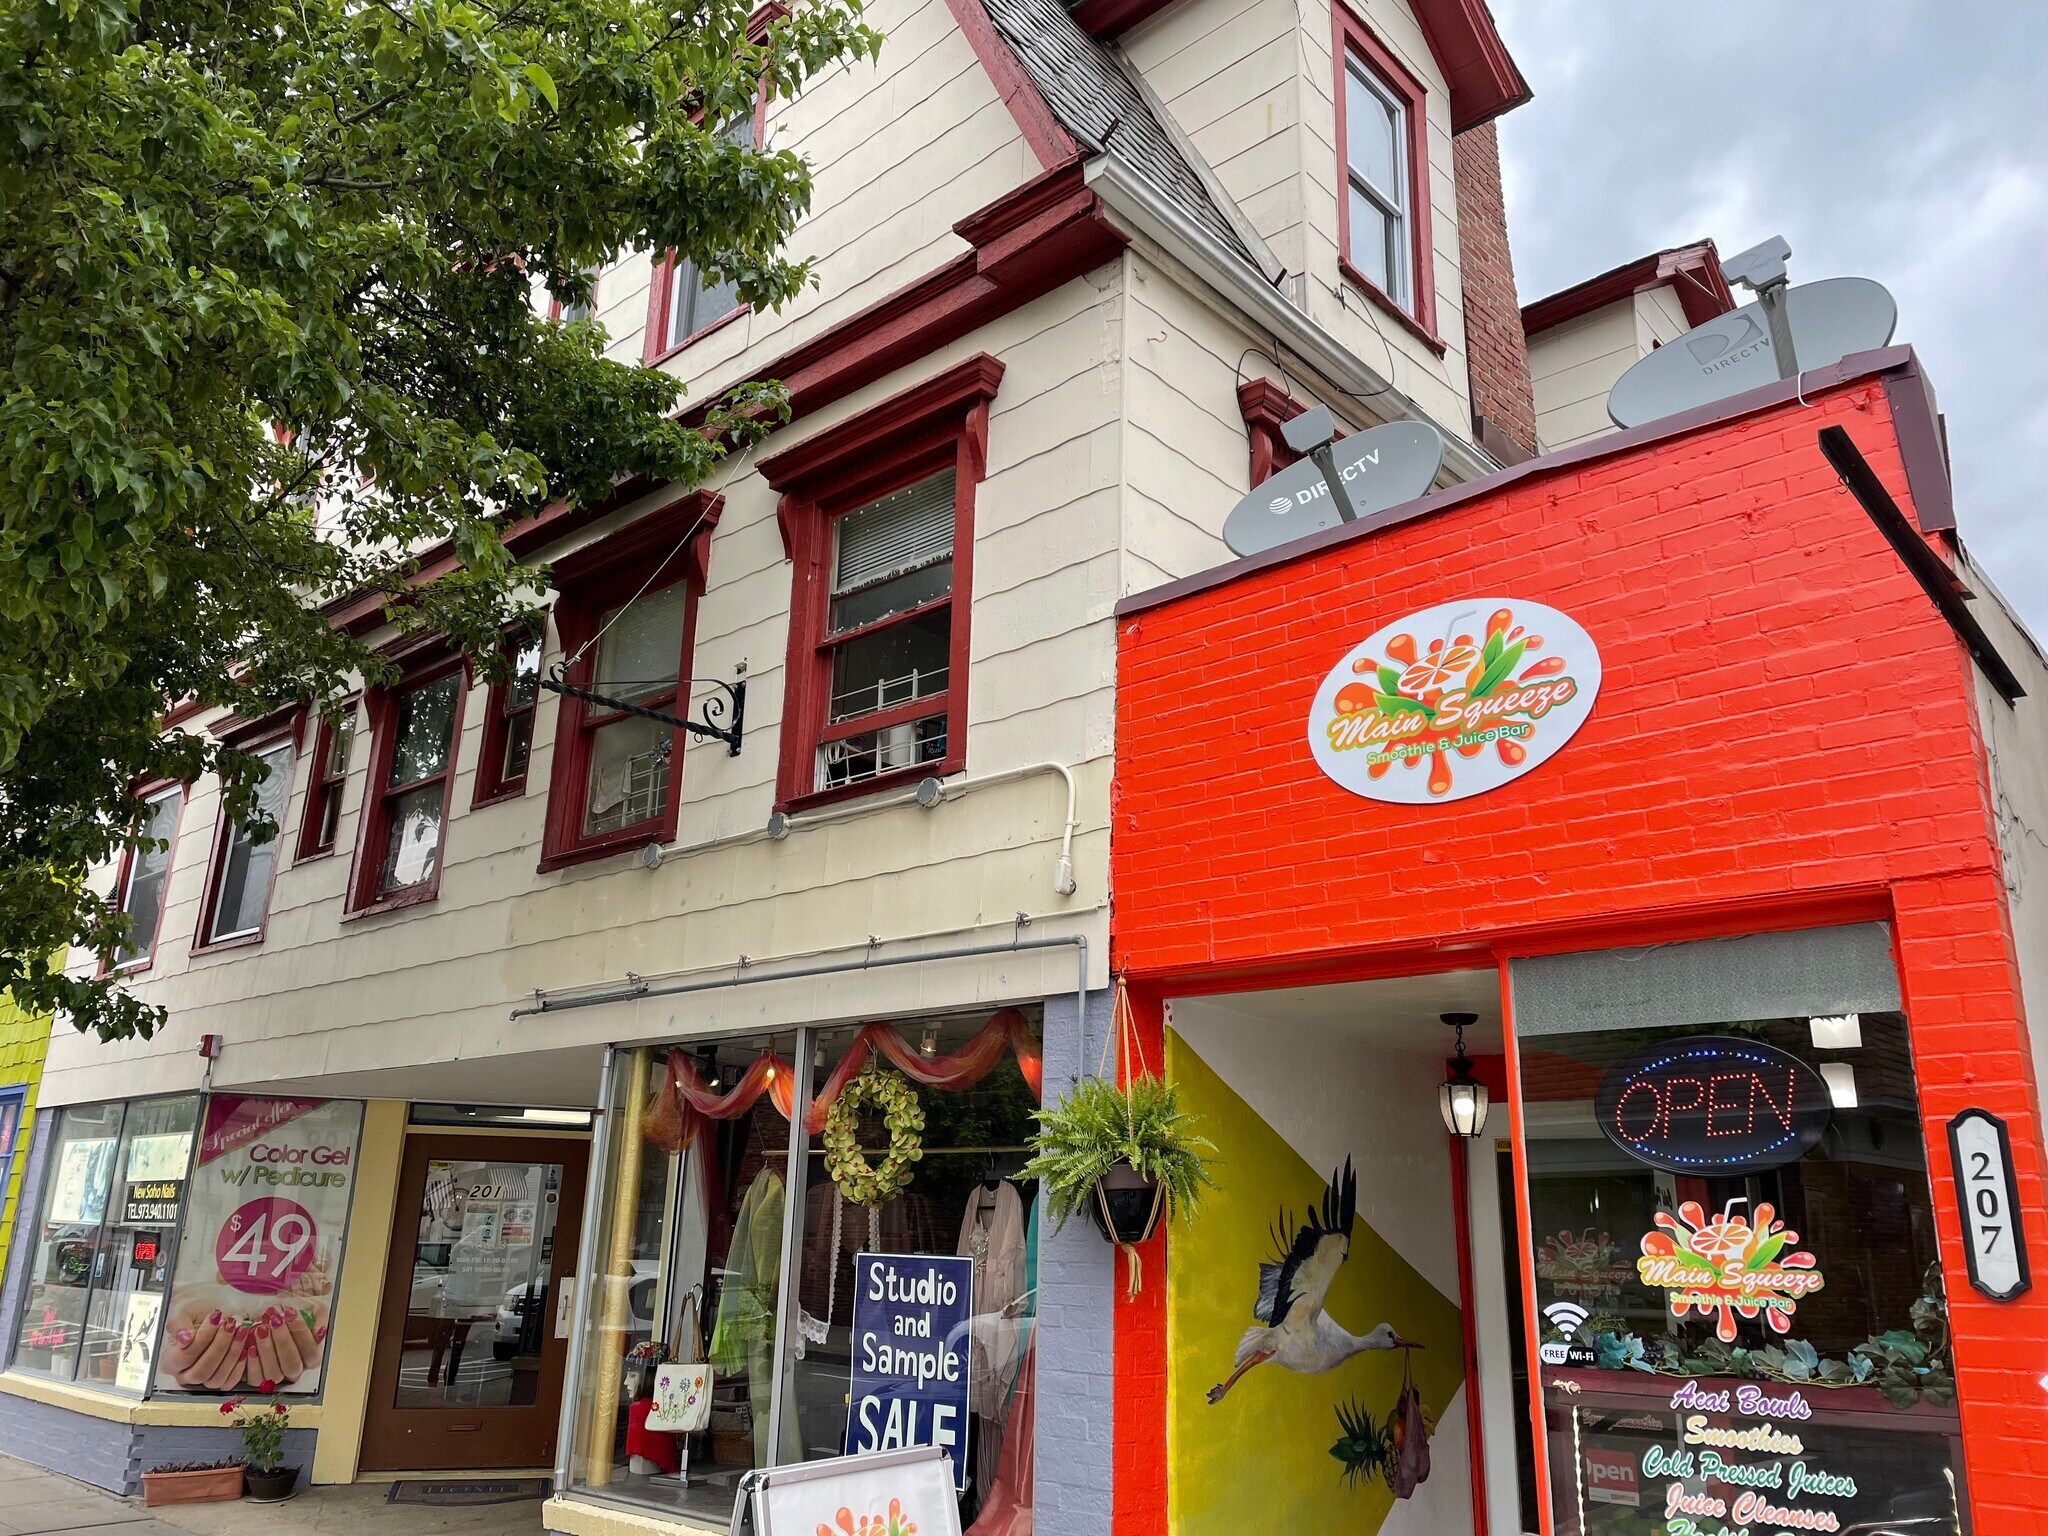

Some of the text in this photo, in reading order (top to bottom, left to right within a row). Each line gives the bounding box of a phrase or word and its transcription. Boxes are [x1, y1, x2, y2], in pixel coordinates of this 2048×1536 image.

[1703, 338, 1770, 376] DIRECTV
[1330, 681, 1573, 748] Main Squeeze
[1367, 722, 1529, 766] Smoothie & Juice Bar
[1616, 1068, 1796, 1142] OPEN
[204, 1100, 294, 1152] Special offer
[250, 1143, 350, 1166] Color Gel
[133, 1185, 146, 1199] New
[161, 1183, 176, 1199] Nails
[220, 1165, 347, 1188] w/ Pedicure
[469, 1185, 502, 1198] 201
[1971, 1152, 2003, 1255] 207
[135, 1243, 156, 1260] OPEN
[869, 1261, 957, 1306] Studio
[1640, 1260, 1822, 1294] Main Squeeze
[1670, 1291, 1791, 1309] Smoothie & Juice Bar
[894, 1312, 930, 1338] and
[862, 1332, 960, 1390] Sample
[1544, 1349, 1594, 1362] FREE Wi-Fi
[1670, 1379, 1812, 1419] Acai Bowls
[1684, 1415, 1803, 1455] Smoothies
[1642, 1445, 1857, 1499] Cold Pressed Juices
[1664, 1483, 1726, 1519] Juice
[1732, 1490, 1841, 1533] Cleanses
